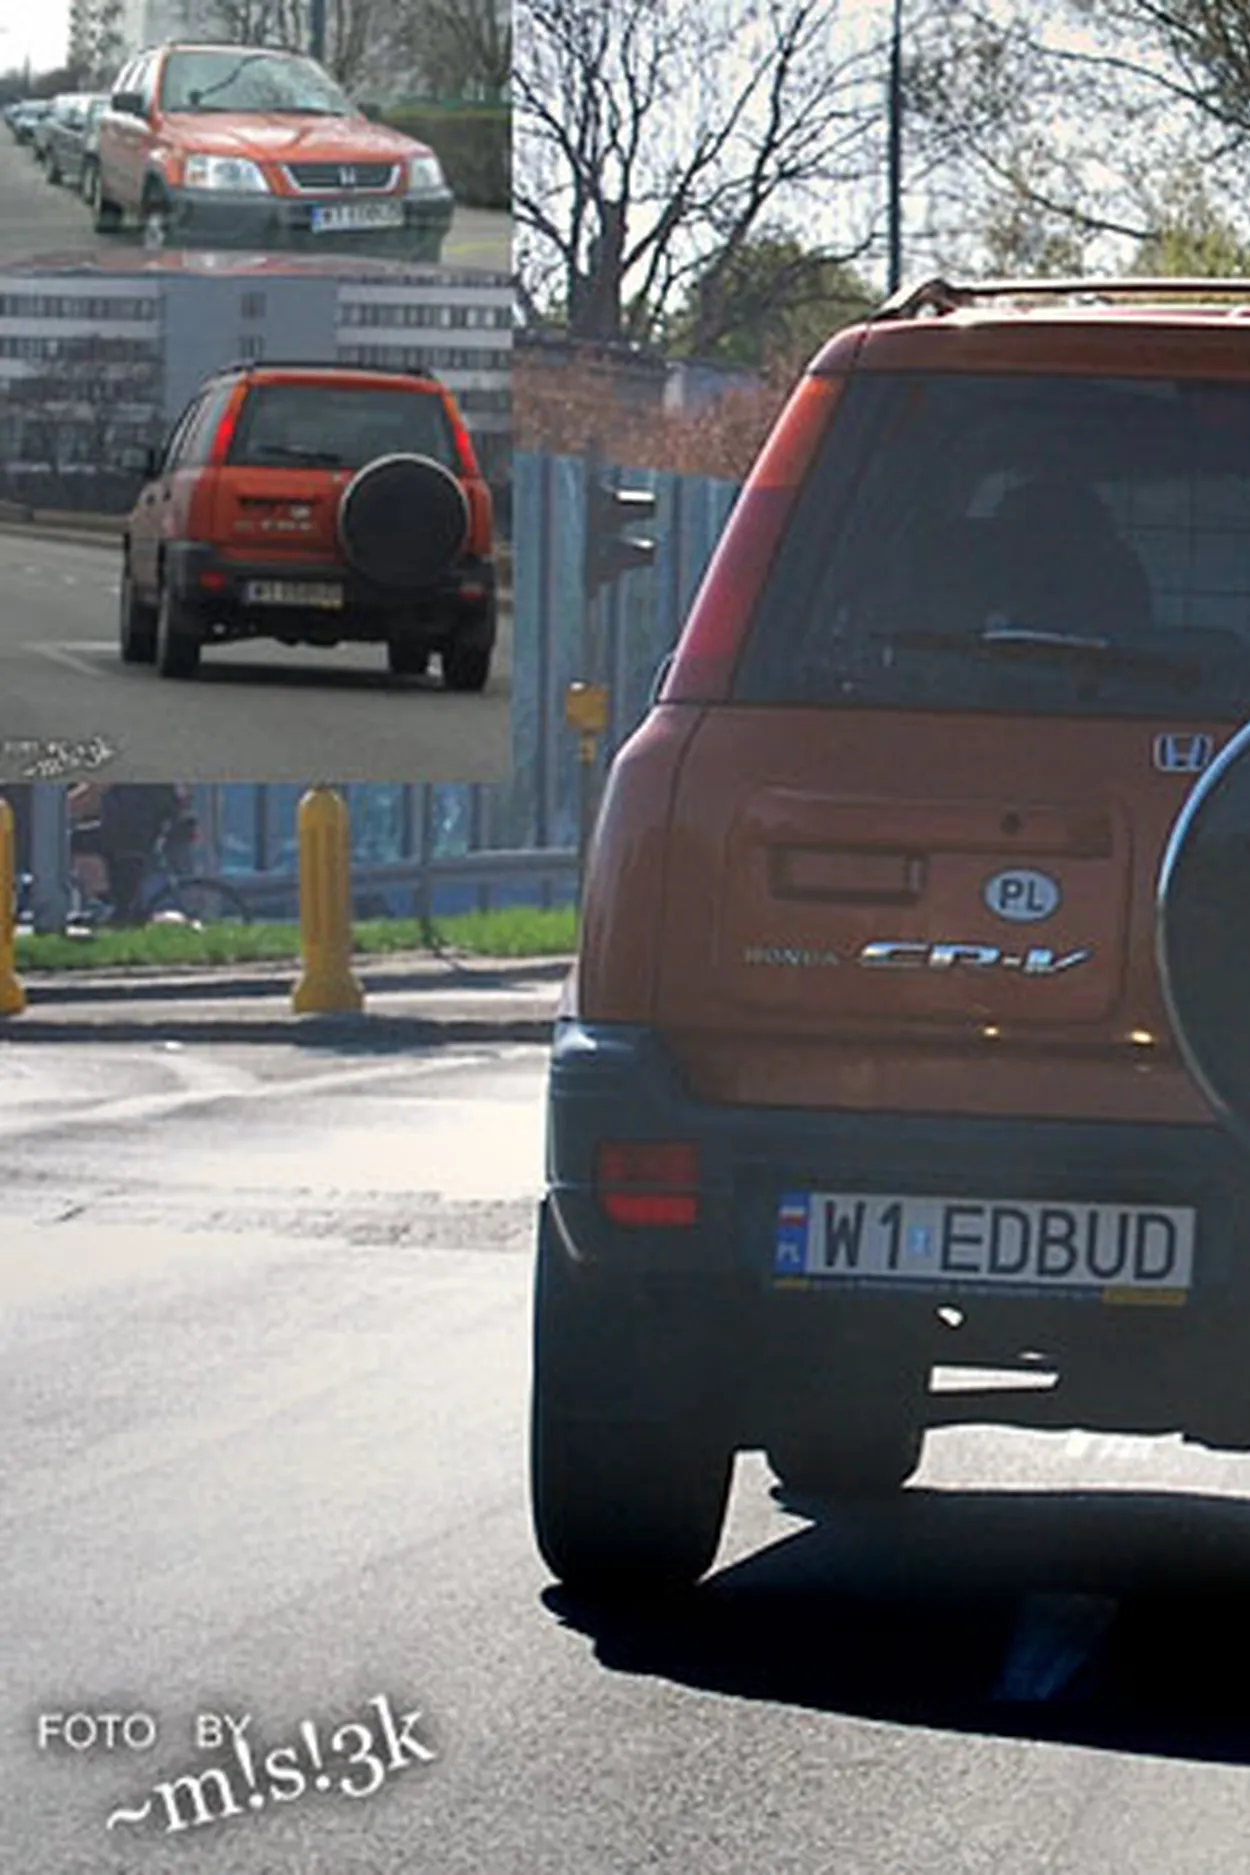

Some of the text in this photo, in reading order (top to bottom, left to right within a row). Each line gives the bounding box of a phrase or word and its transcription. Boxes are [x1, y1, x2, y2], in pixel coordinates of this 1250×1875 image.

[999, 877, 1046, 913] PL
[858, 940, 1094, 974] CR-V
[824, 1199, 1178, 1281] W1 EDBUD
